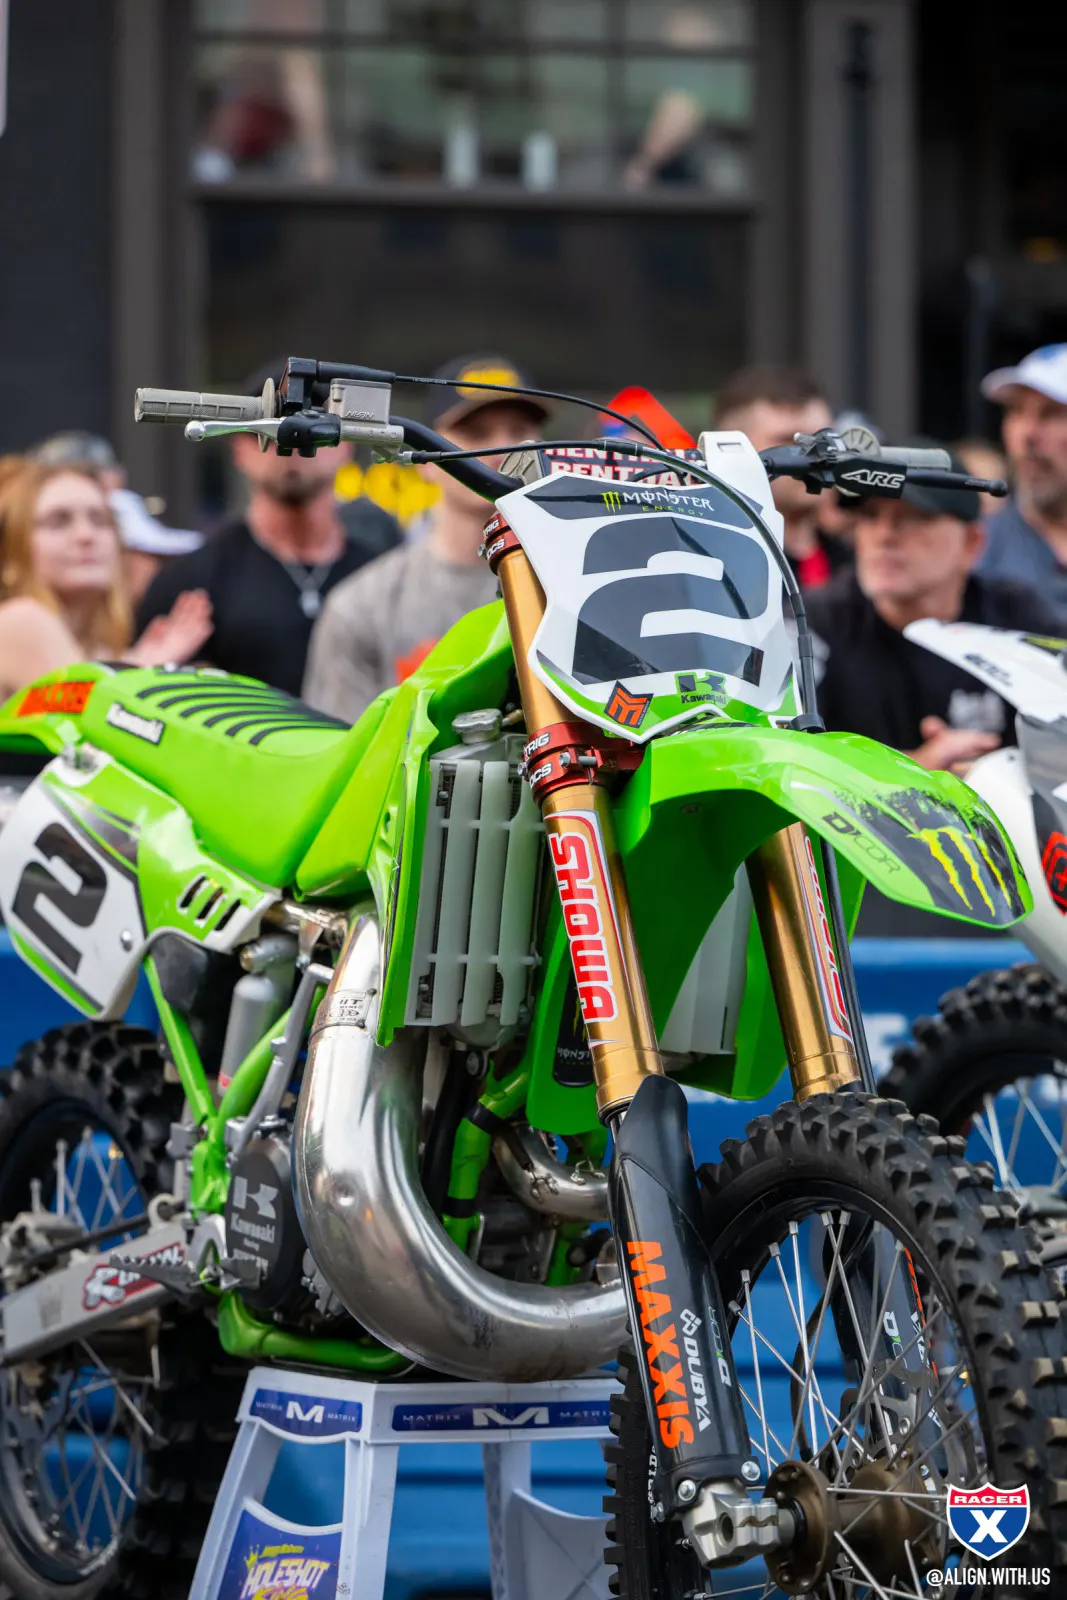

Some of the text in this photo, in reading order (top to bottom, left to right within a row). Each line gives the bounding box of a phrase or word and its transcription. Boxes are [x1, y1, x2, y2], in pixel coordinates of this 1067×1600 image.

[841, 470, 905, 488] ARC
[622, 490, 714, 511] MONSTER
[641, 505, 704, 517] ENERGY
[571, 516, 769, 688] 2
[681, 693, 726, 704] Kawasaki
[11, 822, 108, 976] 2
[548, 831, 619, 1023] SHOWA
[627, 1240, 695, 1449] MAXXIS
[684, 1336, 712, 1433] DUBYA
[327, 1413, 356, 1422] MATRIX
[403, 1414, 461, 1422] MATRIX
[240, 1558, 330, 1600] HOLESHOT
